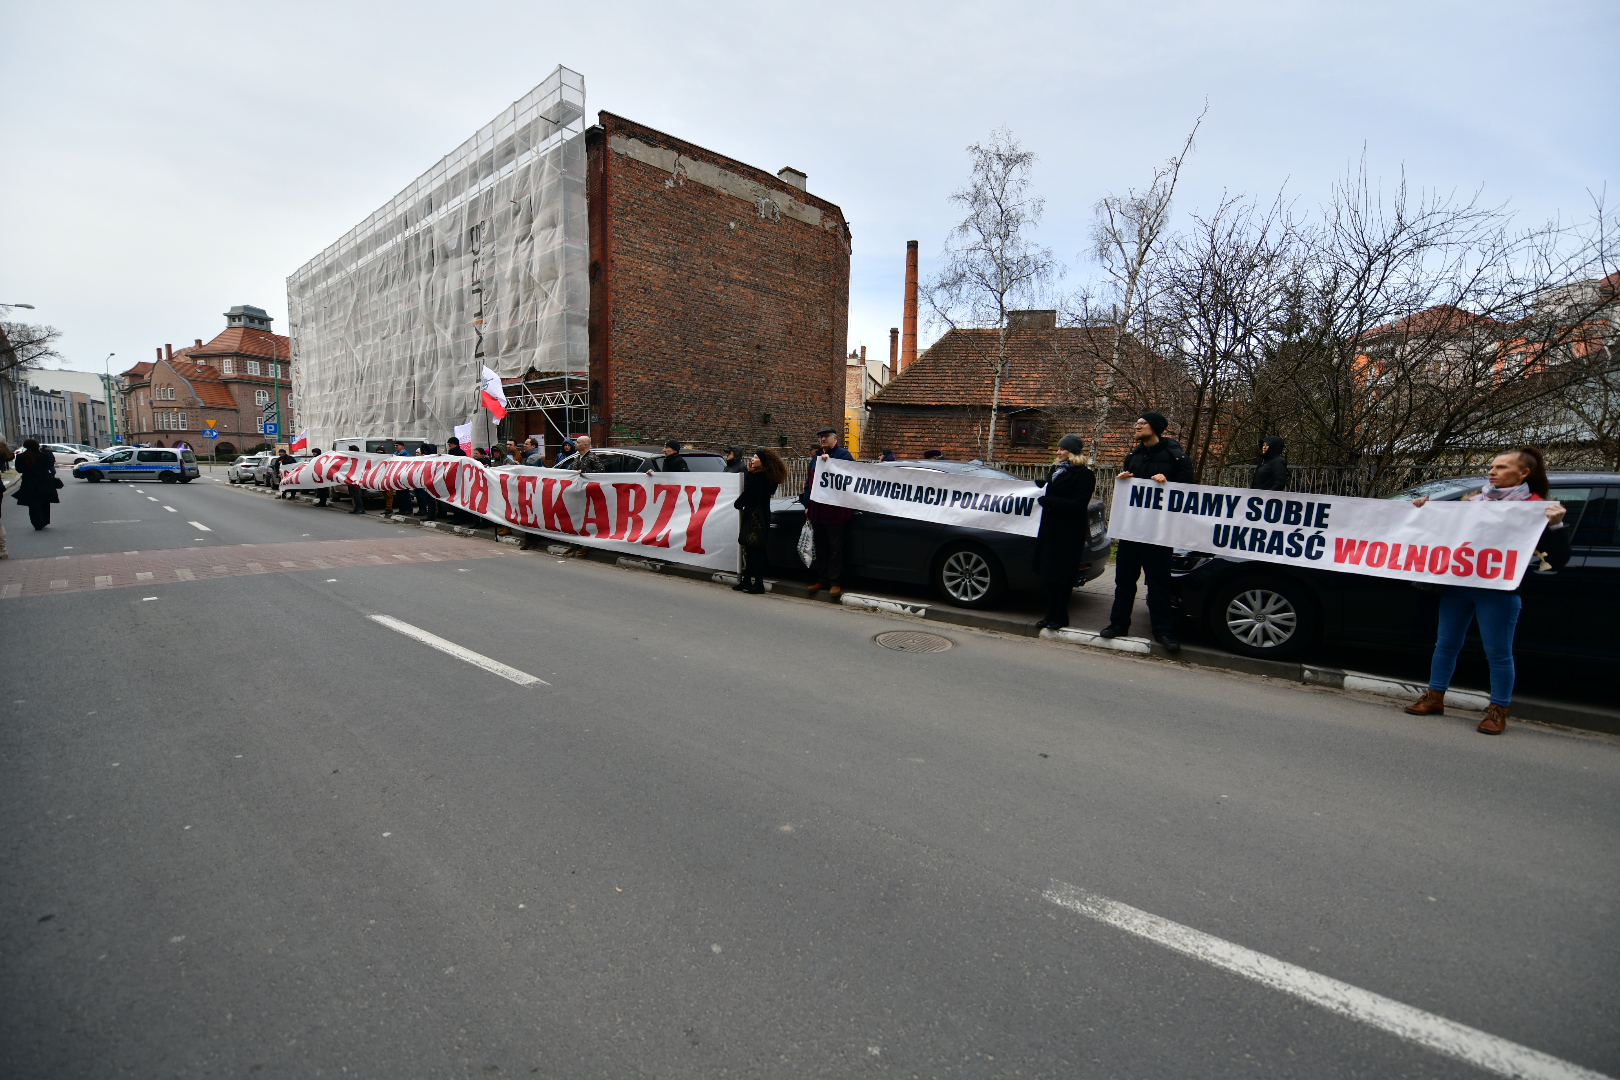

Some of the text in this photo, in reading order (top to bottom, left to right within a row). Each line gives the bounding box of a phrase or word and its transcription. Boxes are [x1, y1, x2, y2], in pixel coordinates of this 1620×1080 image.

[312, 455, 721, 555] SZLACHETNYCH LEKARZY
[820, 472, 1035, 517] STOP INWIGILACJI POLAKÓW
[1129, 485, 1332, 529] NIE DAMY SOBIE
[1212, 523, 1518, 581] UKRAŚĆ WOLNOŚCI
